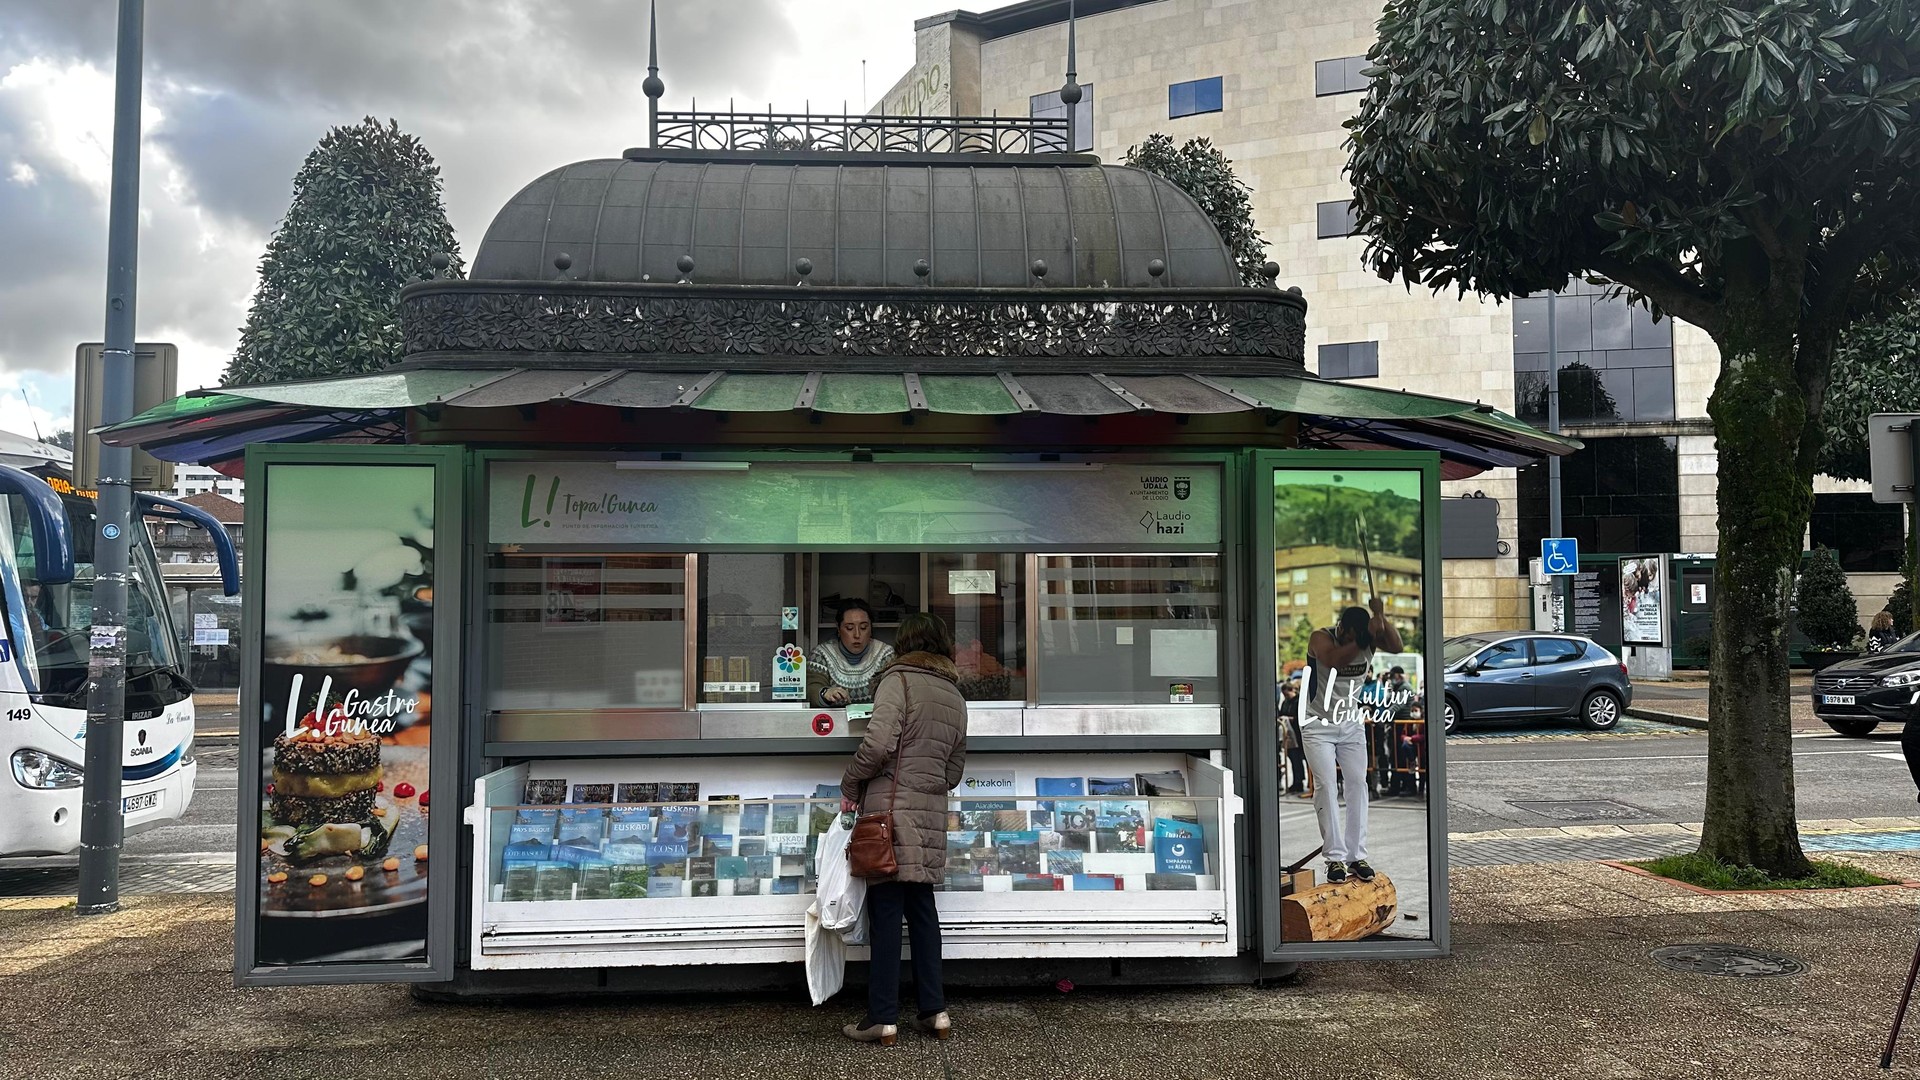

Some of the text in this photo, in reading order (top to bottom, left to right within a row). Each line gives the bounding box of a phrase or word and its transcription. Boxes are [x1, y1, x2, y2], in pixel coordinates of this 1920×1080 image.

[1156, 510, 1191, 521] Laudio
[1156, 521, 1184, 534] hazi
[778, 675, 801, 683] etikoa
[1348, 679, 1415, 708] Kultur
[344, 688, 420, 718] Gastro
[6, 708, 32, 721] 149
[131, 710, 153, 720] IRIZAR
[1332, 699, 1396, 726] Gunea
[325, 708, 397, 736] Gunea
[130, 746, 154, 757] SCANIA
[976, 778, 1012, 788] txakolin
[614, 823, 650, 831] EUSKADI
[771, 835, 804, 843] EUSKADI
[653, 844, 685, 852] COSTA
